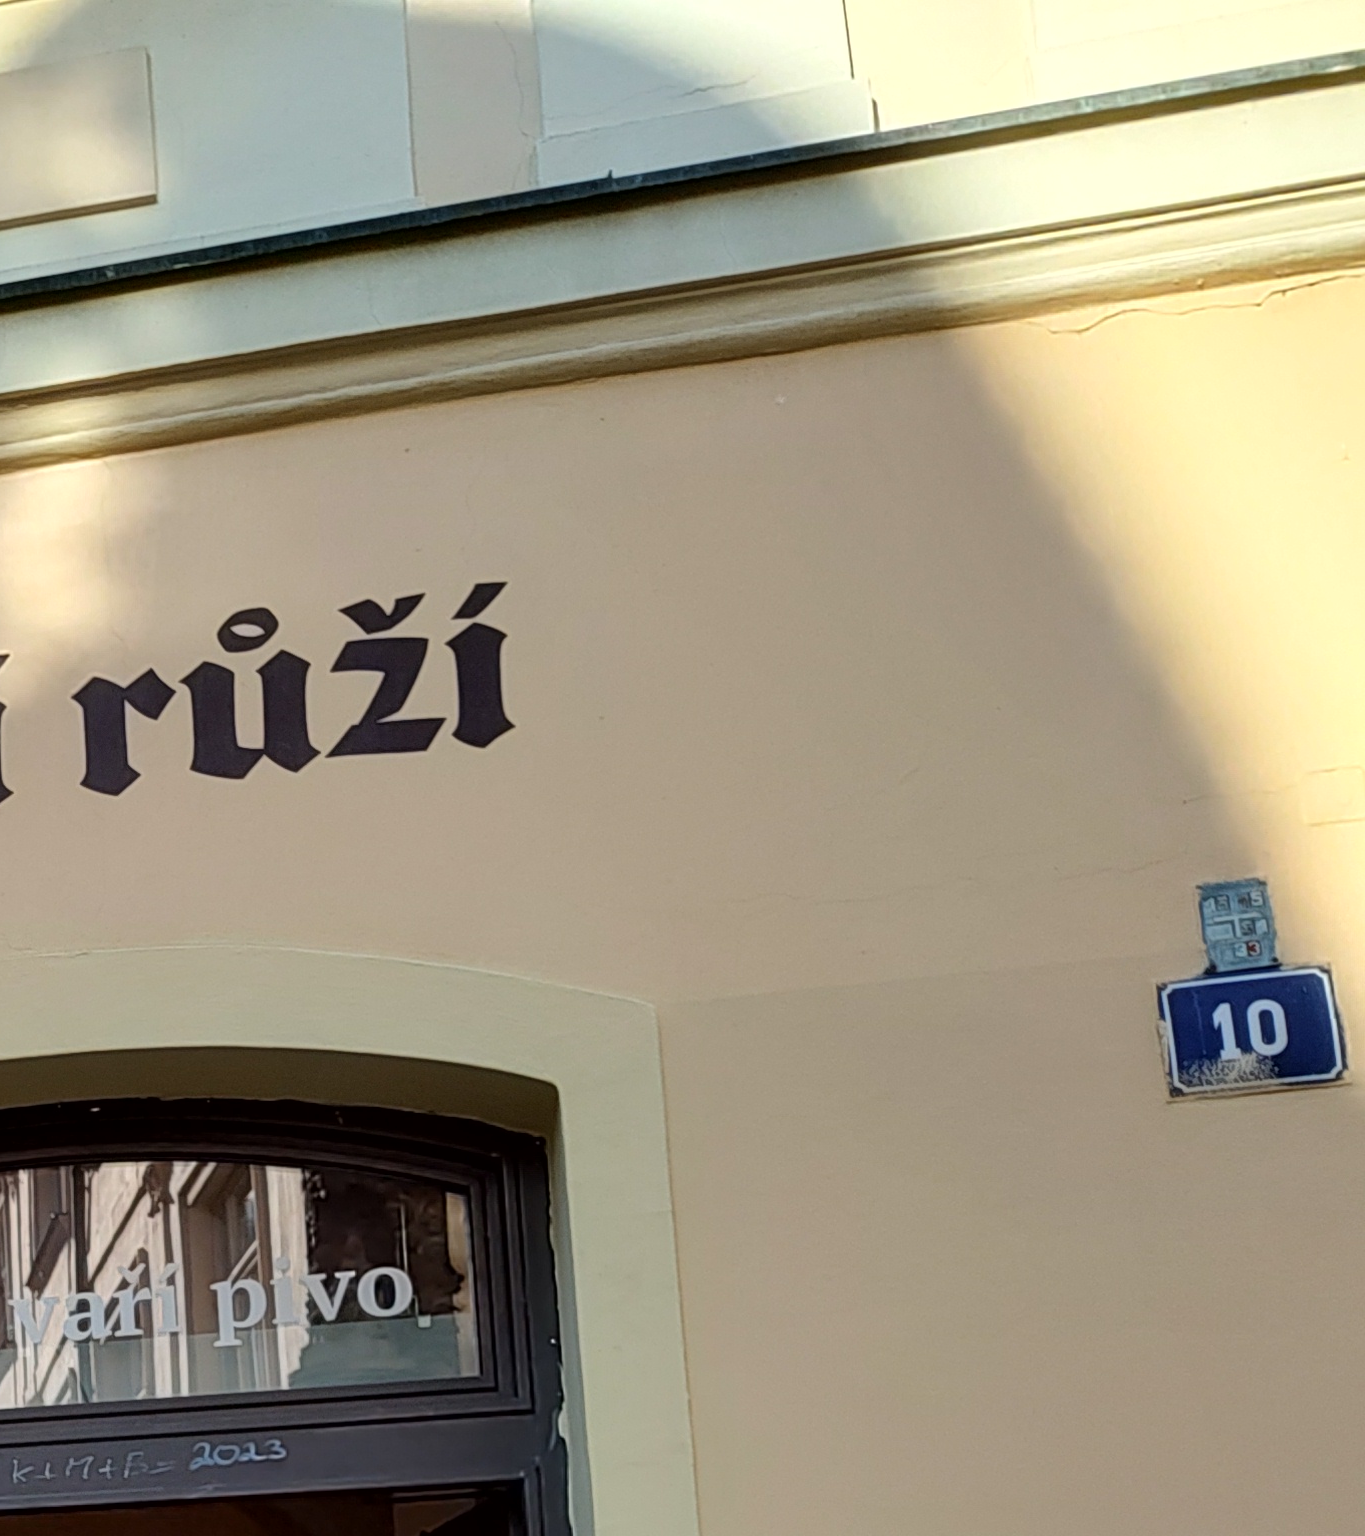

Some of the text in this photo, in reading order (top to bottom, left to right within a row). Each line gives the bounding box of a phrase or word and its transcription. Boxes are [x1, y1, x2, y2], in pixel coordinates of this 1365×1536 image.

[71, 581, 516, 797] růží
[1212, 998, 1288, 1061] 10
[8, 1260, 182, 1346] vaří
[210, 1255, 416, 1348] pivo
[188, 1438, 288, 1472] 2023
